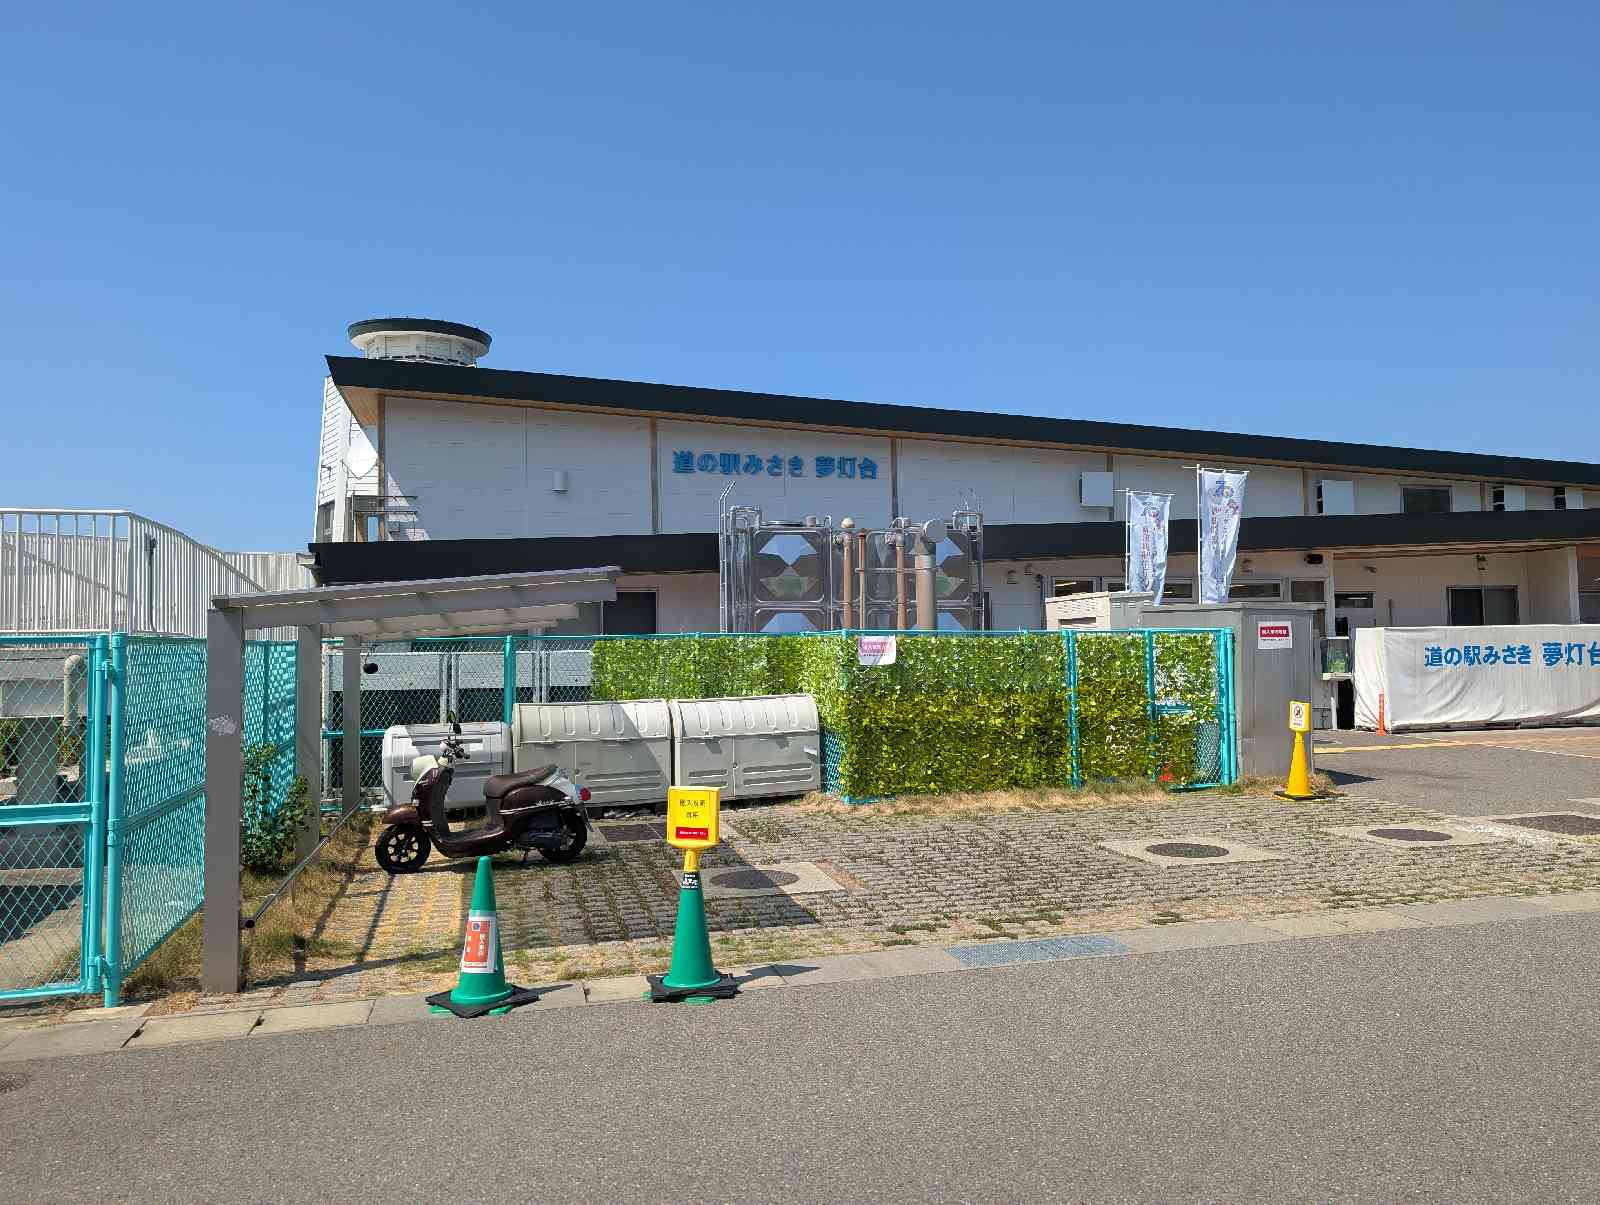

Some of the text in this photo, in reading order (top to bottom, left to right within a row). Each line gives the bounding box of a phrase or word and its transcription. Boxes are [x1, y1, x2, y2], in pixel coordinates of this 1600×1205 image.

[673, 451, 879, 480] 道の駅みさき 夢灯台
[1424, 644, 1531, 667] 道の駅みさき
